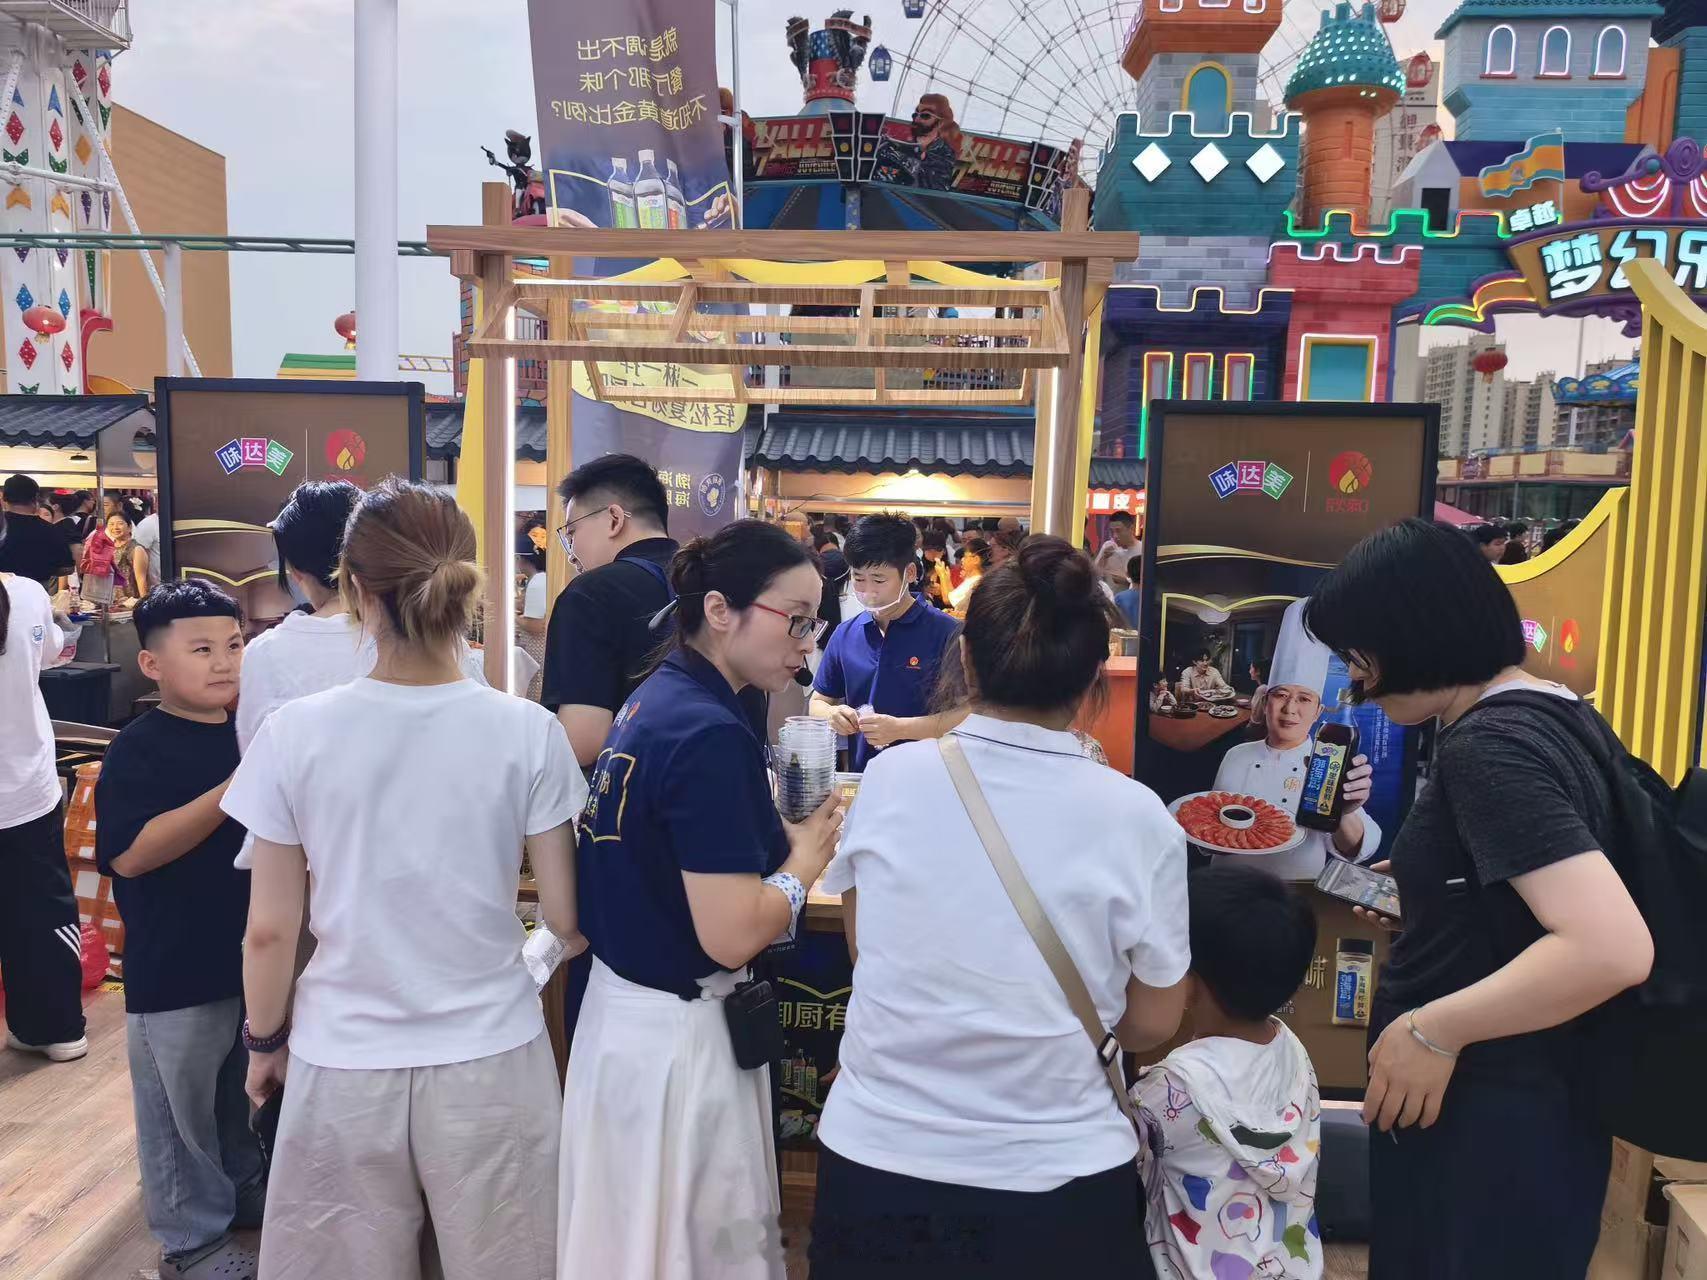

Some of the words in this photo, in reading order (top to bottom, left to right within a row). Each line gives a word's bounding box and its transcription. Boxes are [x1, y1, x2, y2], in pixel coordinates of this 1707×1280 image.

[217, 439, 291, 474] 味达美
[1211, 463, 1290, 497] 味达美
